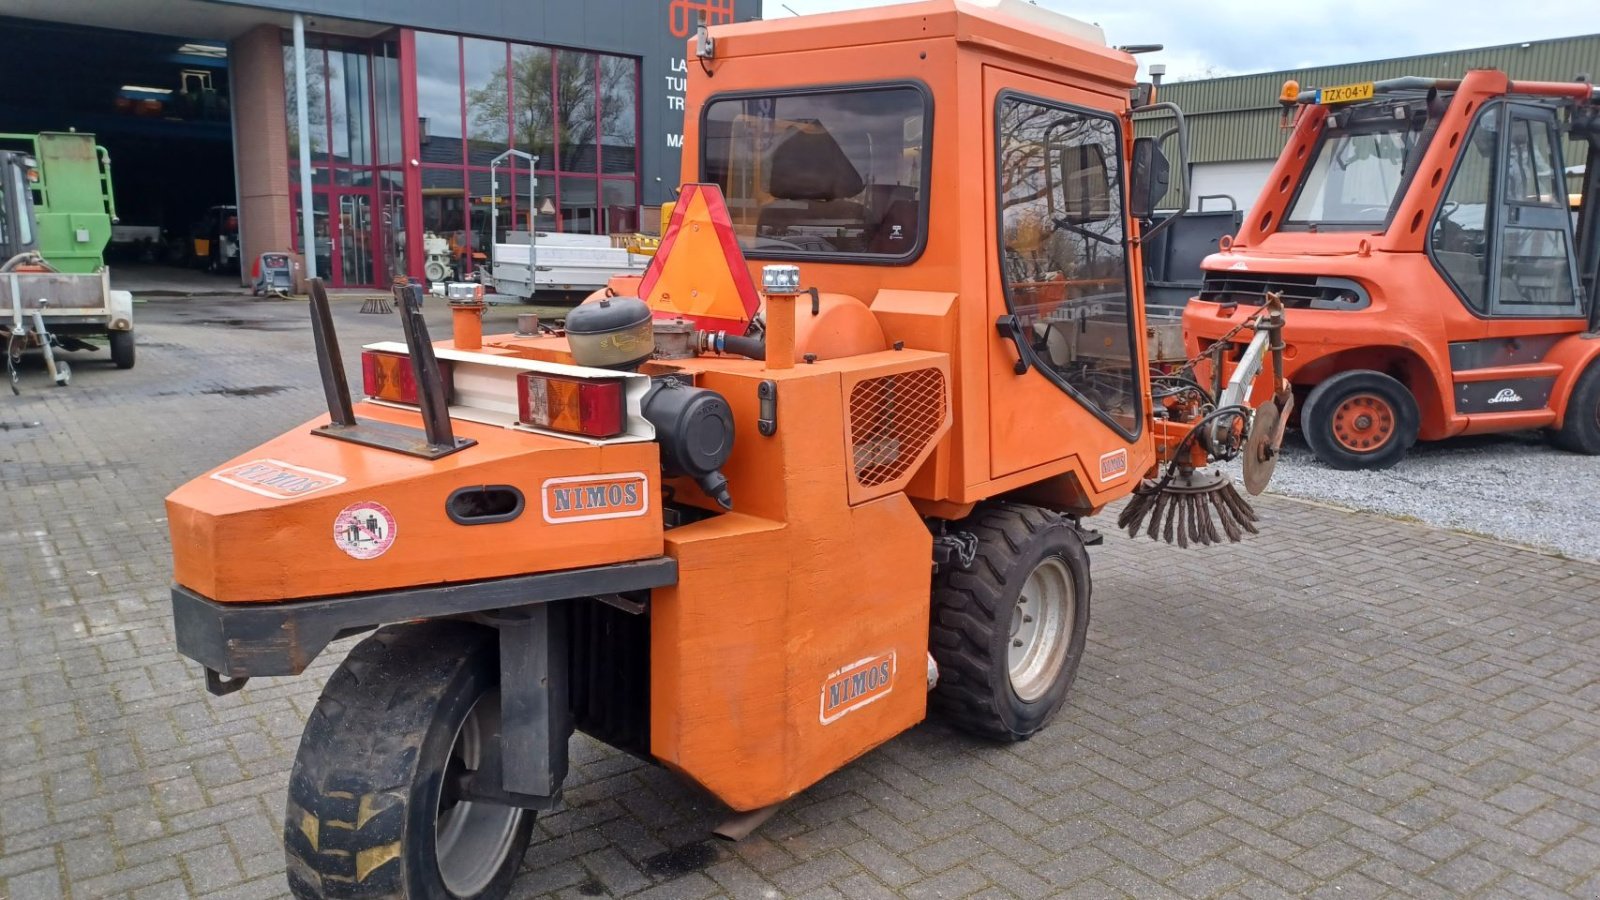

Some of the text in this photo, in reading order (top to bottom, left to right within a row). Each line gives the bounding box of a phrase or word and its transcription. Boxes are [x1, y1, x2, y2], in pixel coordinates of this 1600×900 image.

[1324, 85, 1369, 102] TZX-04-V
[1488, 388, 1523, 404] Linde
[554, 483, 638, 512] NIMOS
[828, 660, 889, 711] NIMOS
